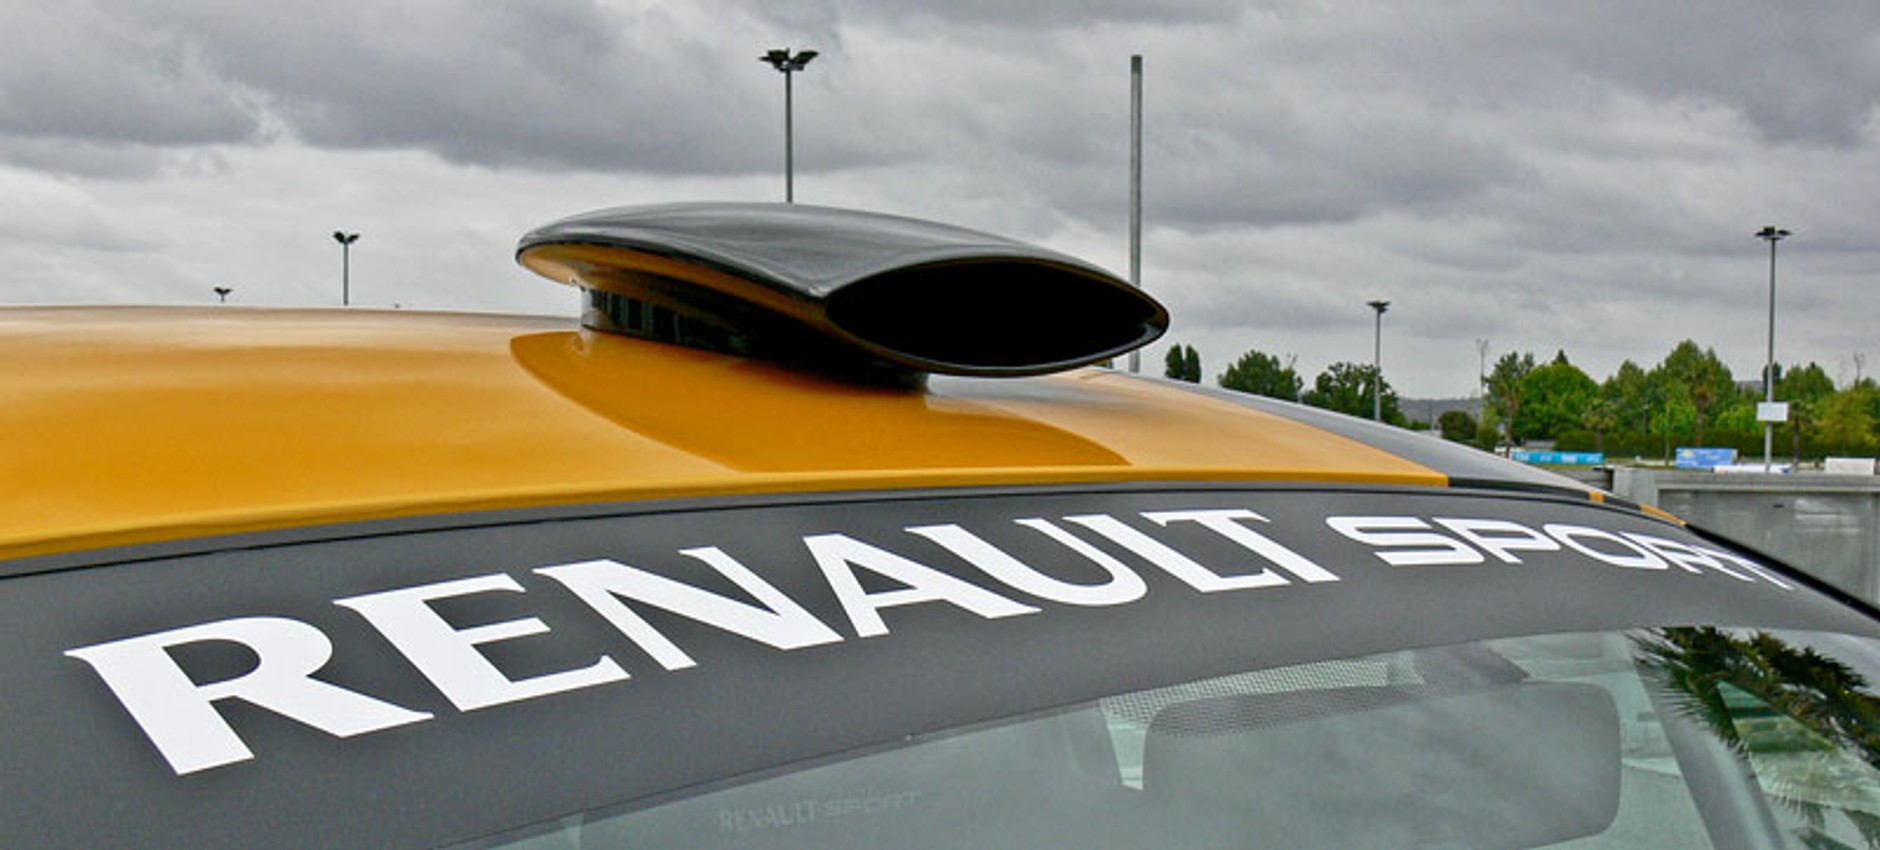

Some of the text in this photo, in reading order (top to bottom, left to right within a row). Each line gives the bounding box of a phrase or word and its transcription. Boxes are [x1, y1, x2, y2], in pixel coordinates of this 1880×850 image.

[64, 510, 1795, 775] RENAULT SPORT
[718, 799, 817, 831] RENAULT
